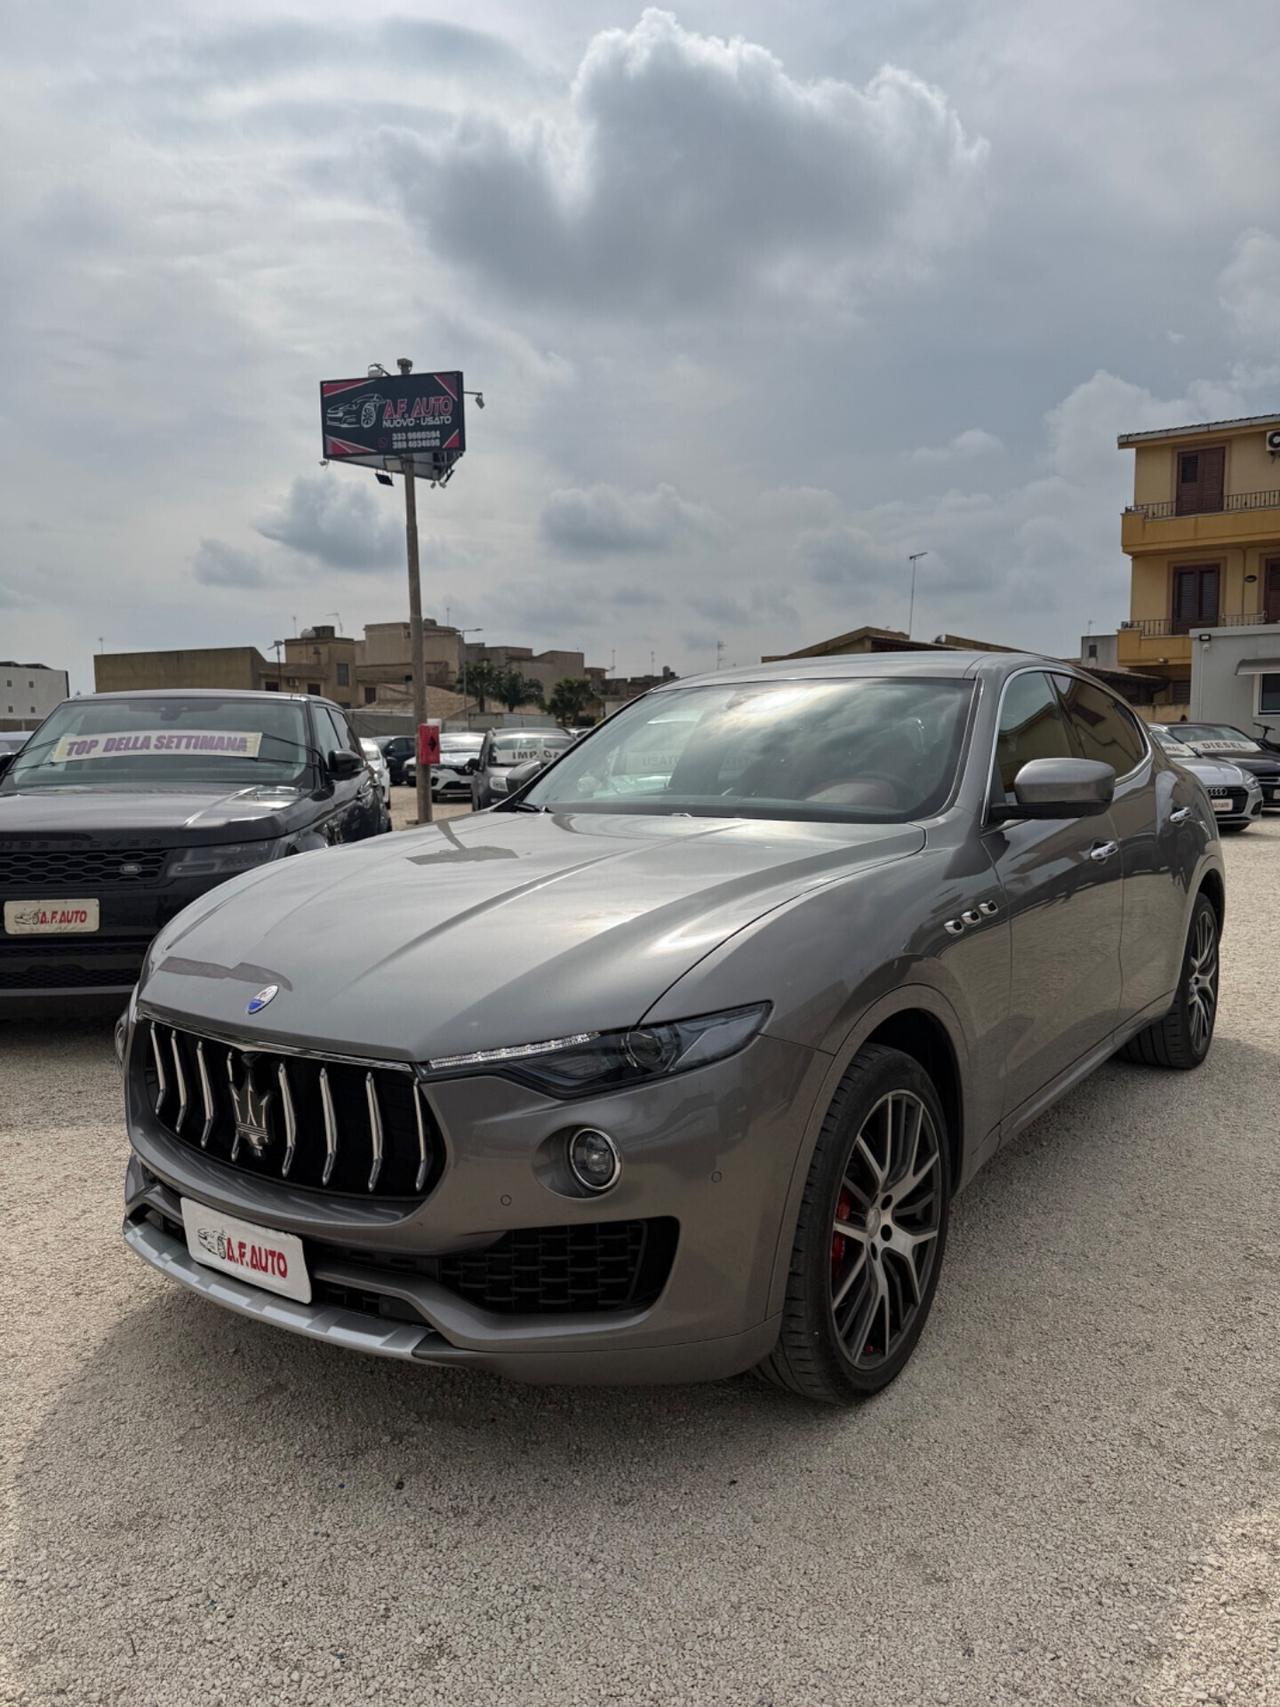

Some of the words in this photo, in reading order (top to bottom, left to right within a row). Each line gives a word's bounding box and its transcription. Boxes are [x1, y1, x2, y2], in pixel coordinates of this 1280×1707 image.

[411, 396, 453, 417] AUTO
[383, 417, 415, 428] NUOVO
[421, 415, 452, 425] USATO
[66, 740, 98, 756] TOP
[103, 736, 149, 752] DELLA
[154, 734, 247, 752] SETTIMANA
[1201, 742, 1246, 750] DIESEL
